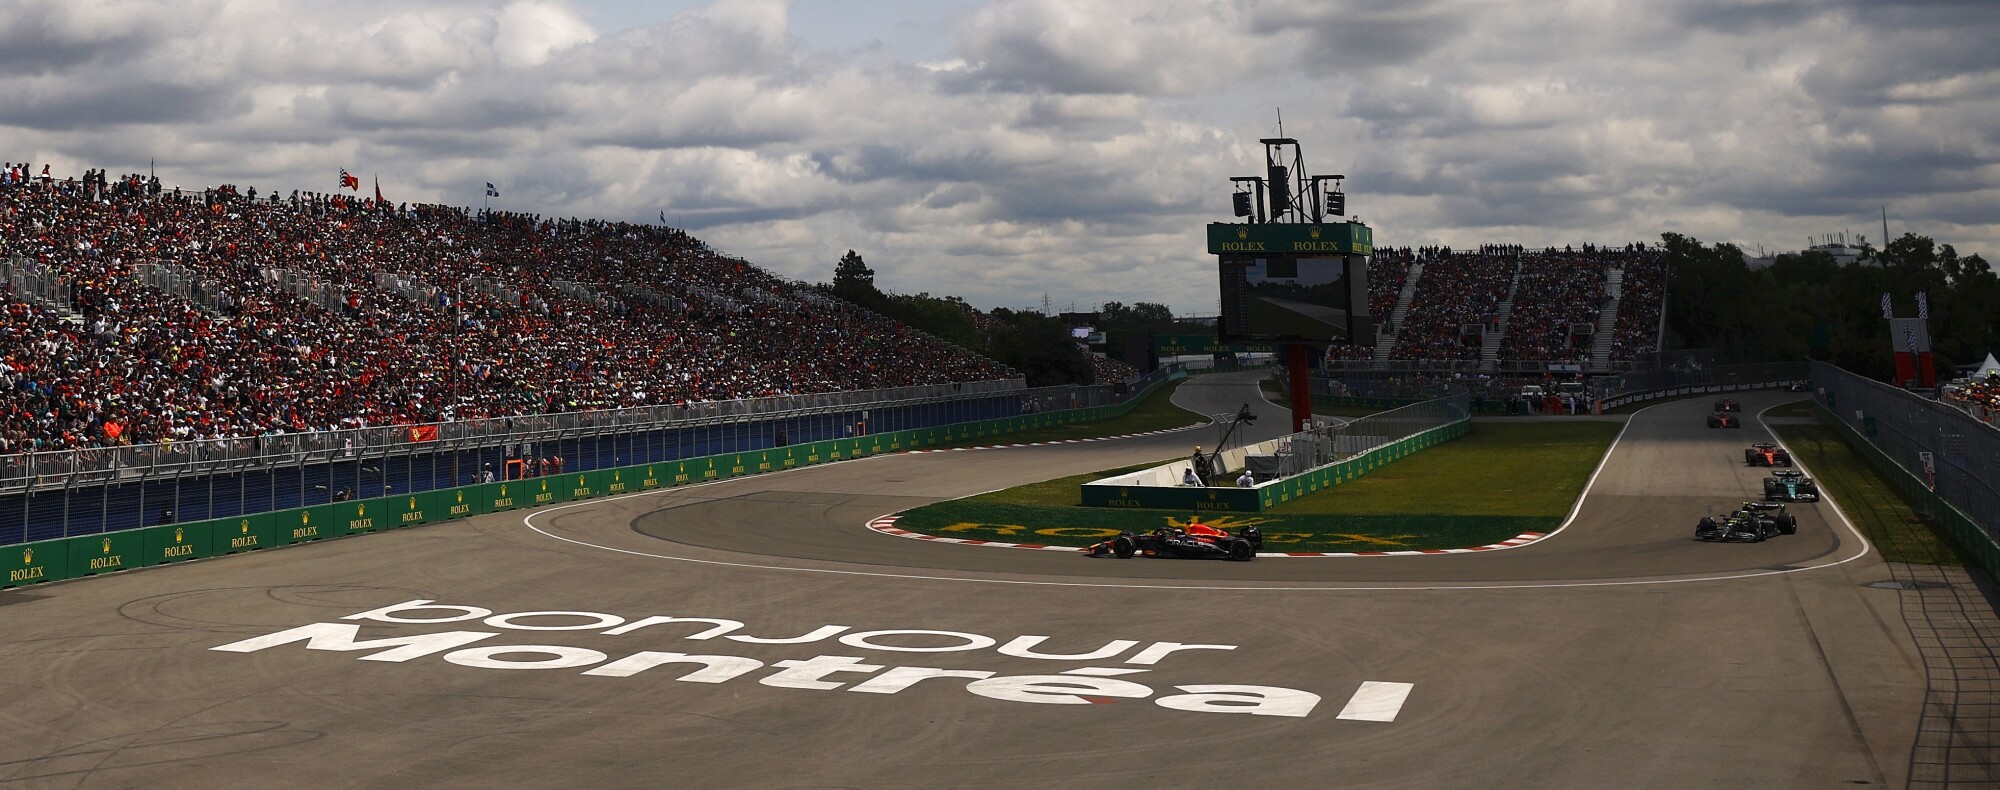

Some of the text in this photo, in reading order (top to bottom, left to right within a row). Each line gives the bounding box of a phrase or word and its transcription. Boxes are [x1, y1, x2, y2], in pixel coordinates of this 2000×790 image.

[1222, 241, 1265, 251] ROLEX
[1293, 241, 1338, 251] ROLEX
[704, 469, 717, 478] ROLEX
[732, 465, 744, 474] ROLEX
[643, 478, 658, 487] ROLEX
[675, 473, 689, 482] ROLEX
[574, 487, 590, 497] ROLEX
[610, 482, 625, 492] ROLEX
[494, 497, 513, 508] ROLEX
[536, 492, 553, 502] ROLEX
[1108, 499, 1142, 508] ROLEX
[1196, 501, 1231, 511] ROLEX
[450, 504, 469, 515] ROLEX
[402, 510, 423, 522] ROLEX
[350, 517, 372, 530] ROLEX
[293, 526, 317, 539] ROLEX
[927, 522, 1430, 547] ROEX
[231, 535, 258, 548] ROLEX
[1165, 538, 1206, 549] ORACLE
[164, 544, 193, 558] ROLEX
[90, 554, 122, 570] ROLEX
[10, 565, 44, 582] ROLEX
[340, 599, 1239, 665] bonjour
[209, 623, 1415, 722] Montréal
